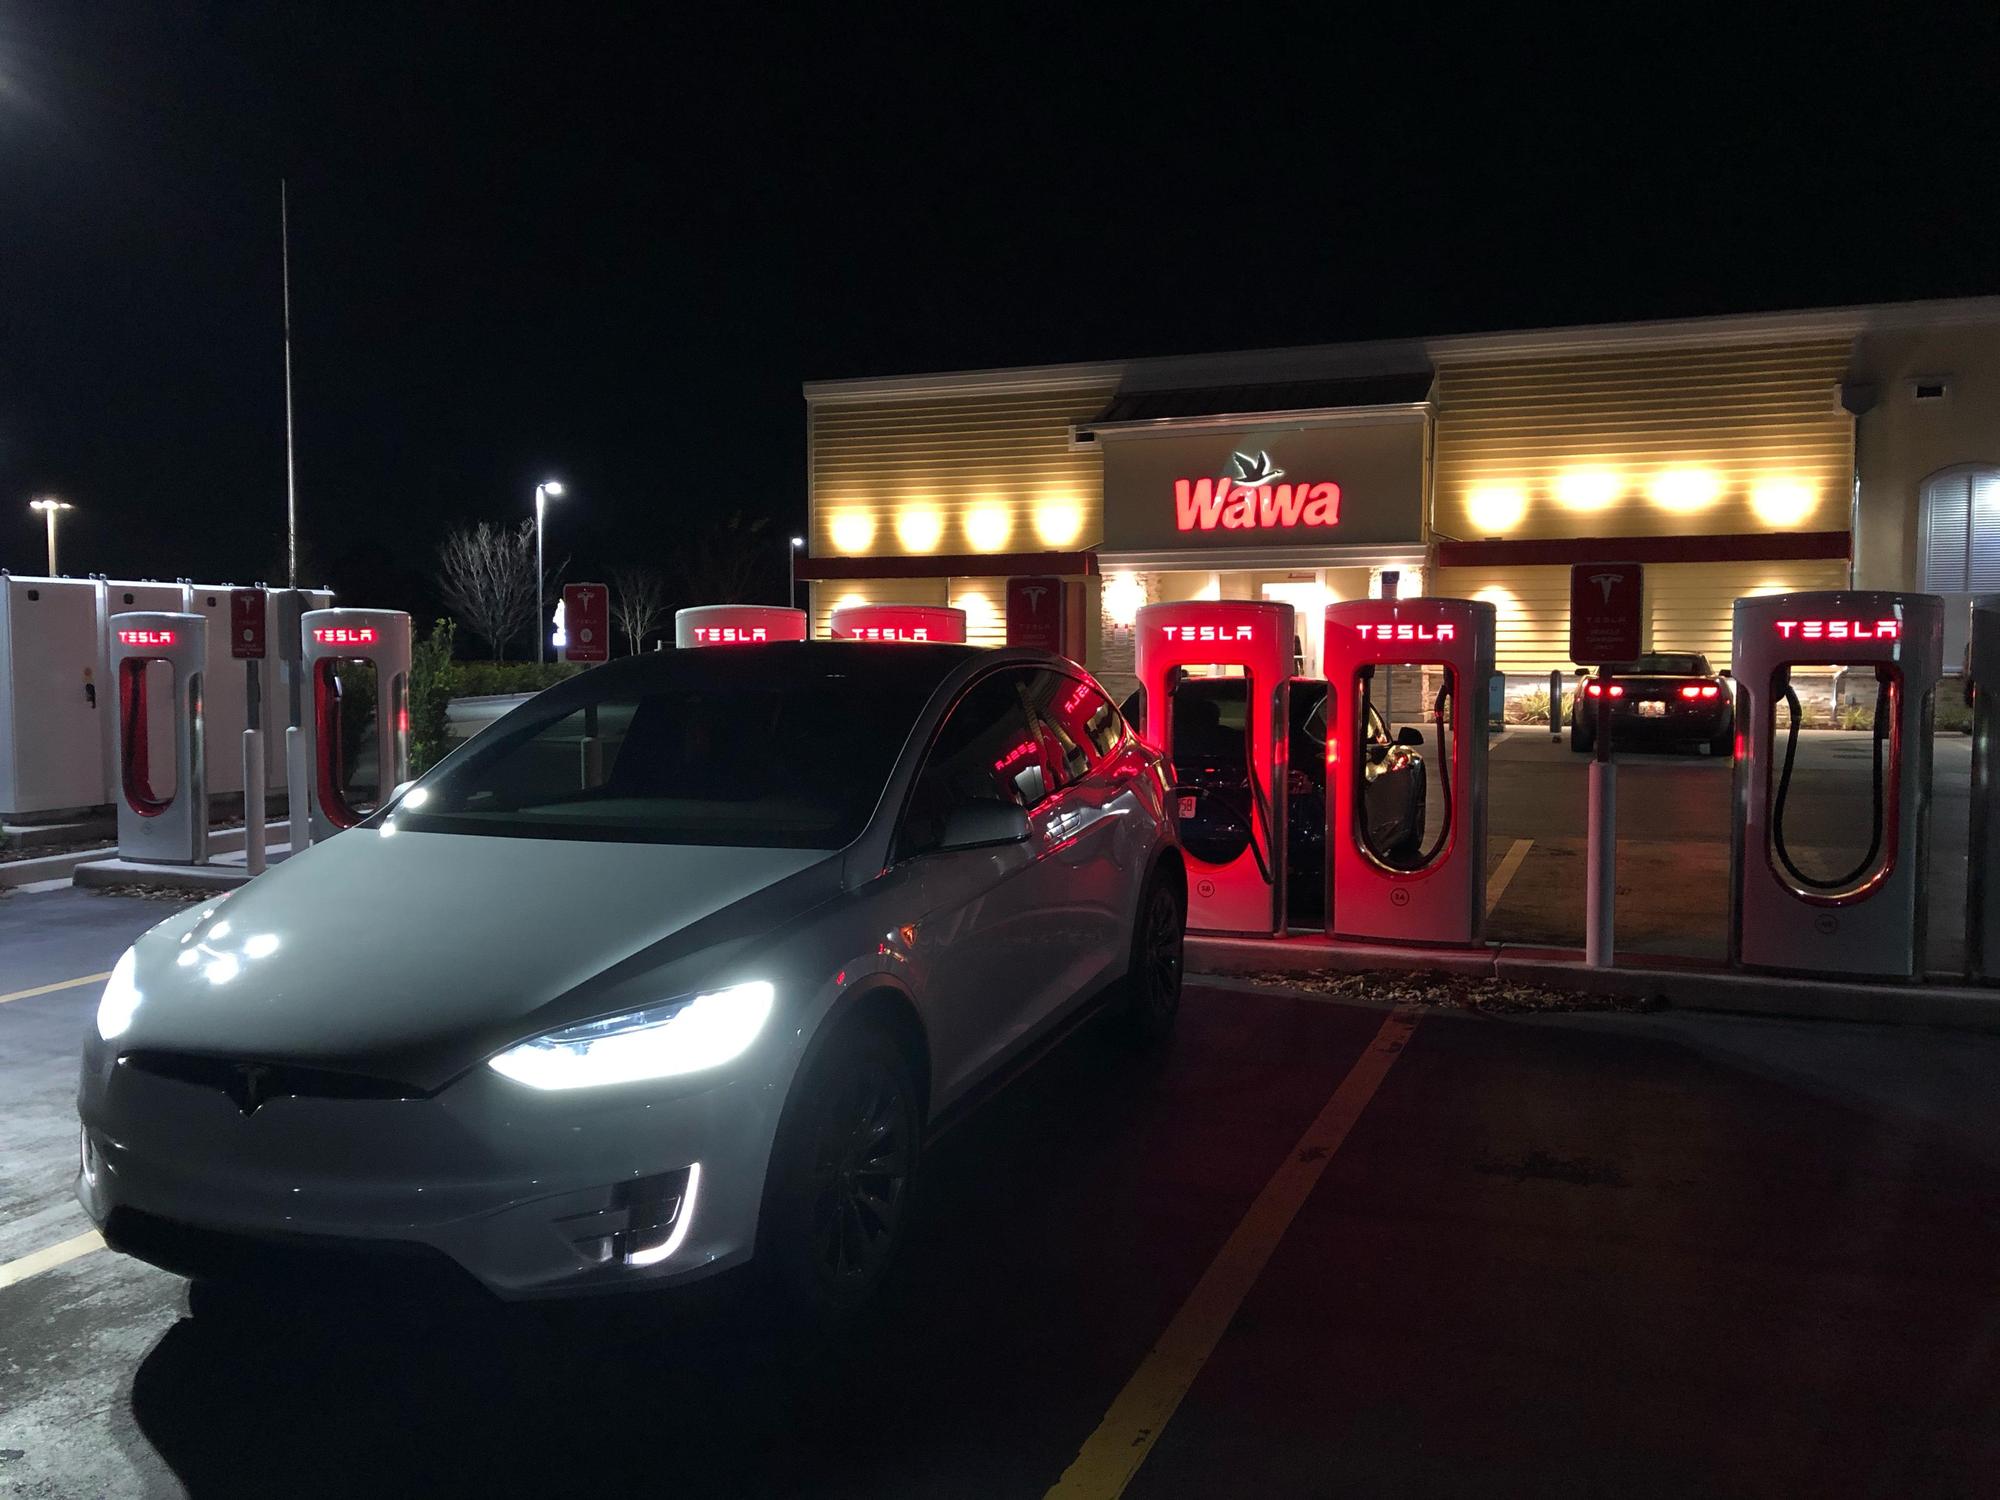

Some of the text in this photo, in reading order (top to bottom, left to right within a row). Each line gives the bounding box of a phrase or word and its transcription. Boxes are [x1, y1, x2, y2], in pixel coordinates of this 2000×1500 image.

[1174, 476, 1341, 532] Wawa
[313, 629, 372, 642] TESLA
[694, 628, 766, 641] TESLA
[851, 628, 927, 641] TESLA
[1162, 625, 1252, 641] TESLA
[1356, 624, 1454, 640] TESLA
[1775, 620, 1897, 638] TESLA
[118, 631, 171, 643] TESLA
